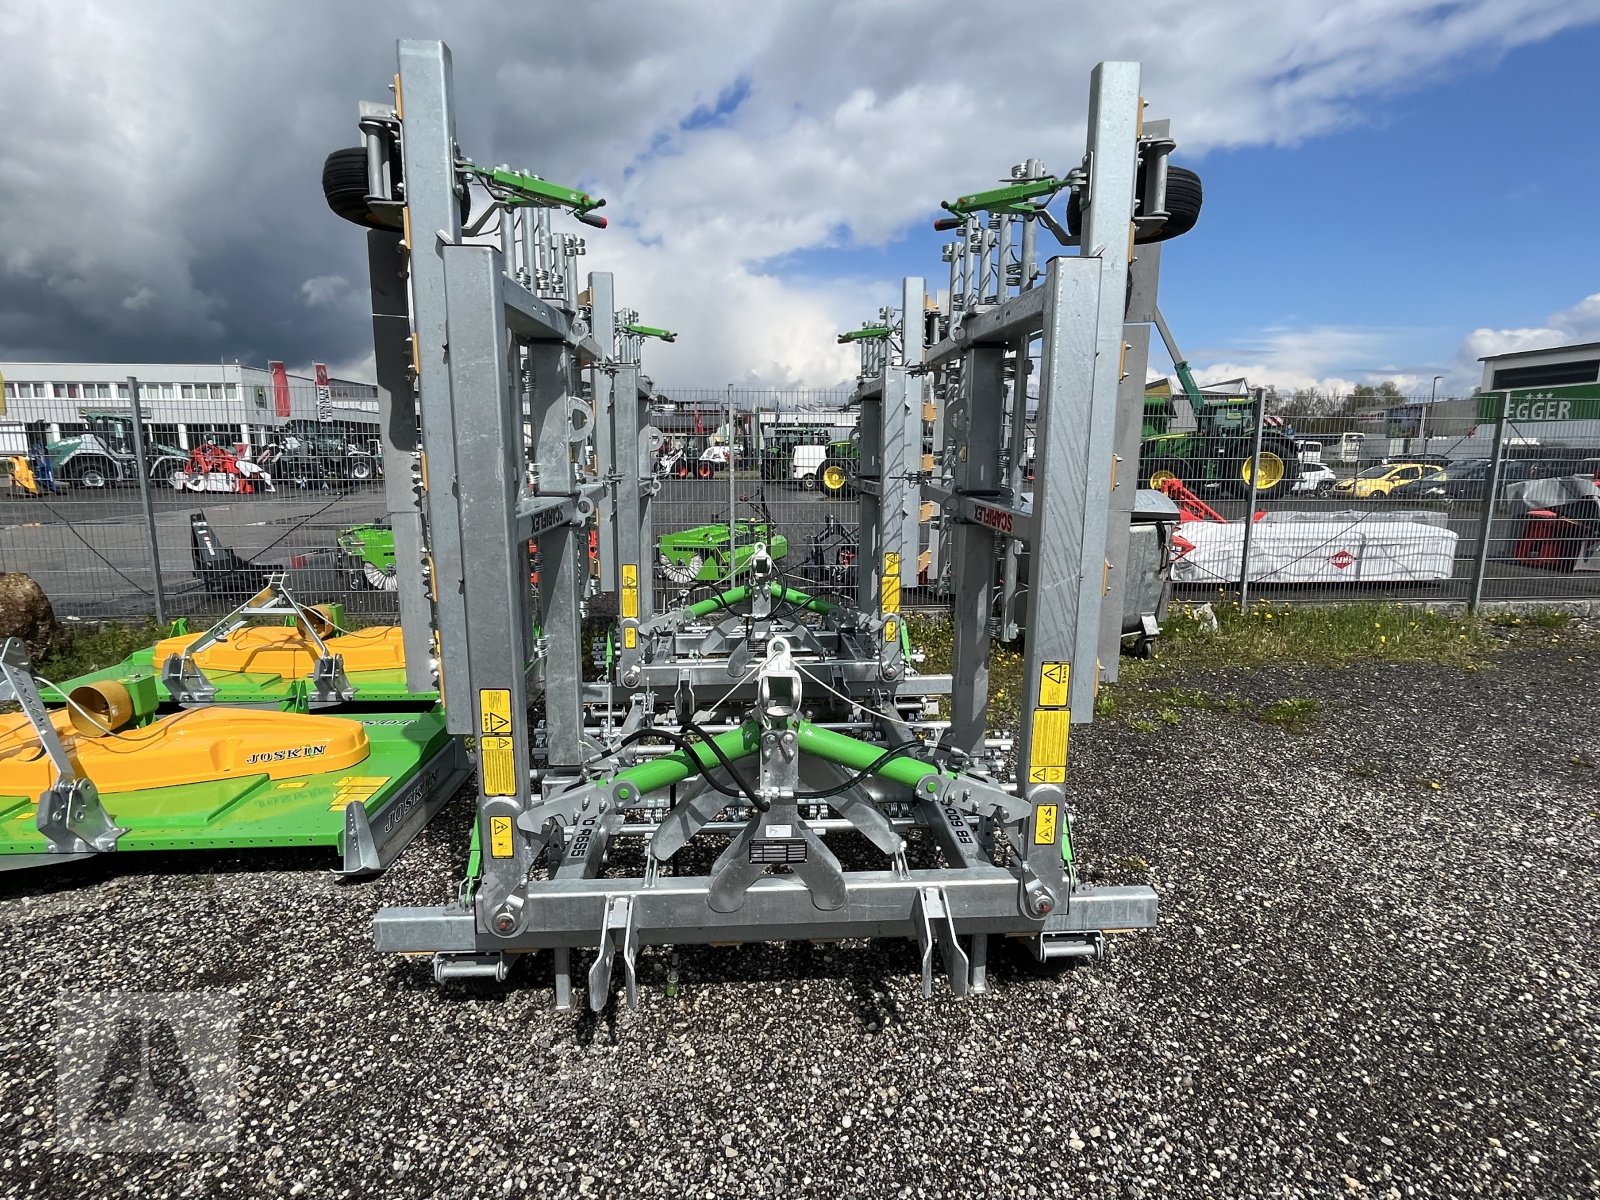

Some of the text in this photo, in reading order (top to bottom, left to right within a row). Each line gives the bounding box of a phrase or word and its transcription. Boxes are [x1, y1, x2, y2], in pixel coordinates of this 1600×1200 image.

[531, 504, 564, 534] SCARIFLEX
[974, 504, 1013, 532] SCARIFLEX
[246, 744, 327, 764] JOSKIN
[384, 767, 440, 833] JOSKIN
[944, 807, 964, 827] 600
[955, 830, 974, 844] EB
